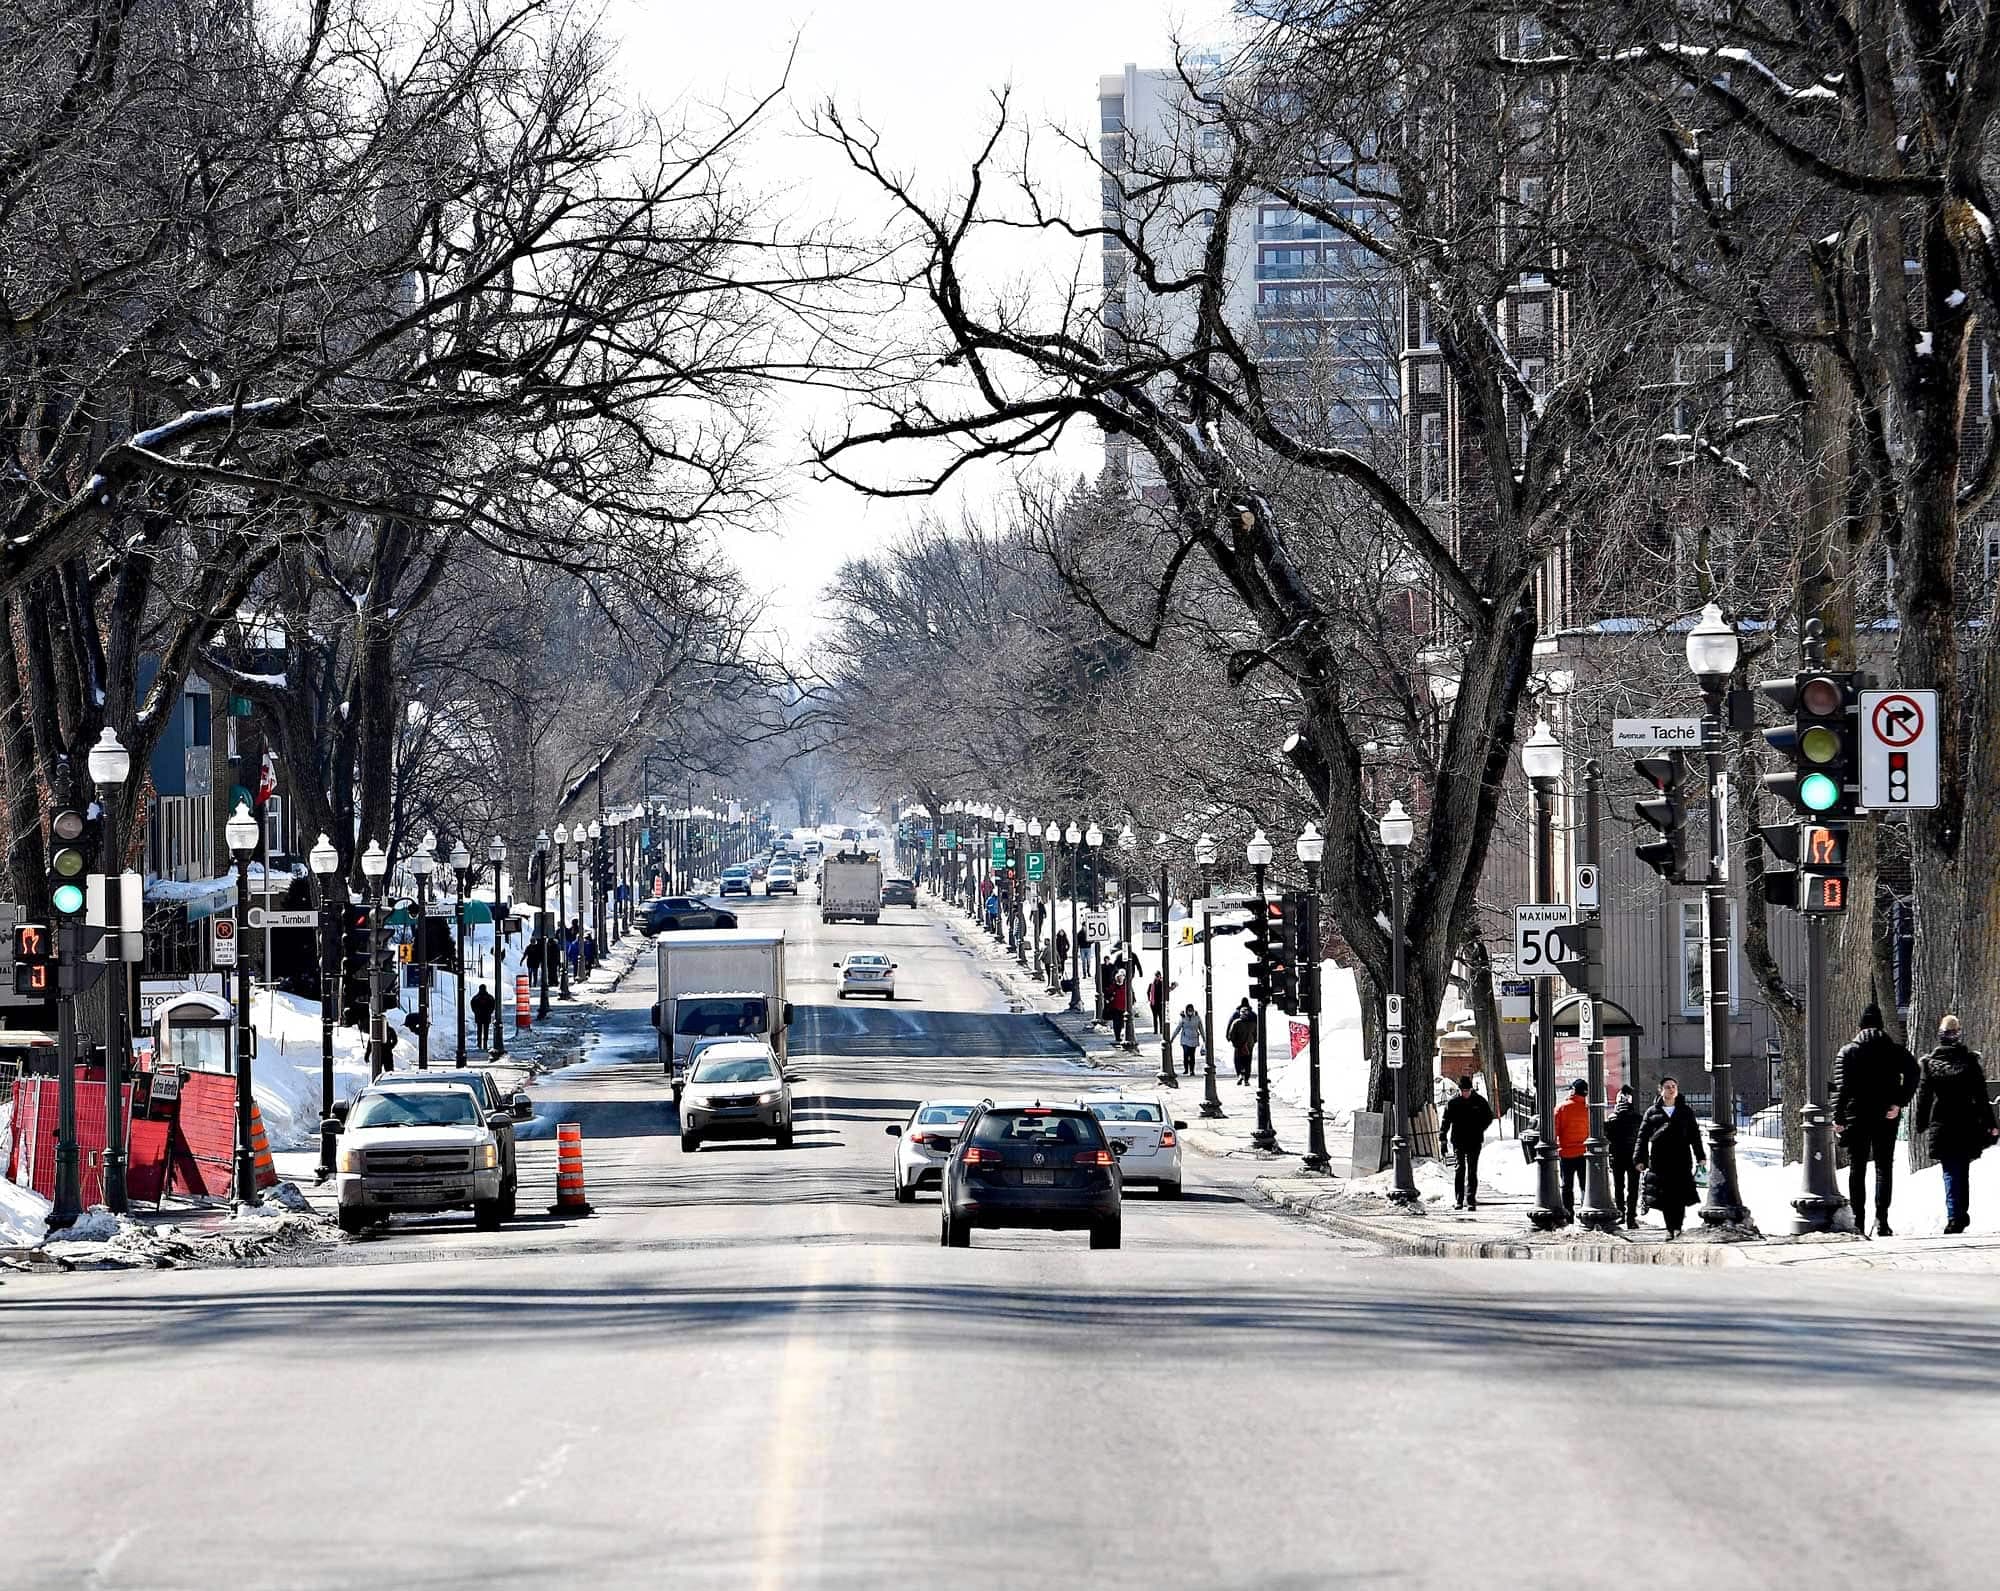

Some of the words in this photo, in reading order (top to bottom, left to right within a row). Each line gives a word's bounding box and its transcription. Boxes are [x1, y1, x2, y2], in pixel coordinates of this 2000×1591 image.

[1650, 725, 1696, 739] Taché
[281, 915, 311, 924] Turnbull
[1519, 912, 1567, 921] MAXIMUM
[1088, 922, 1106, 937] 50
[1522, 930, 1565, 966] 50
